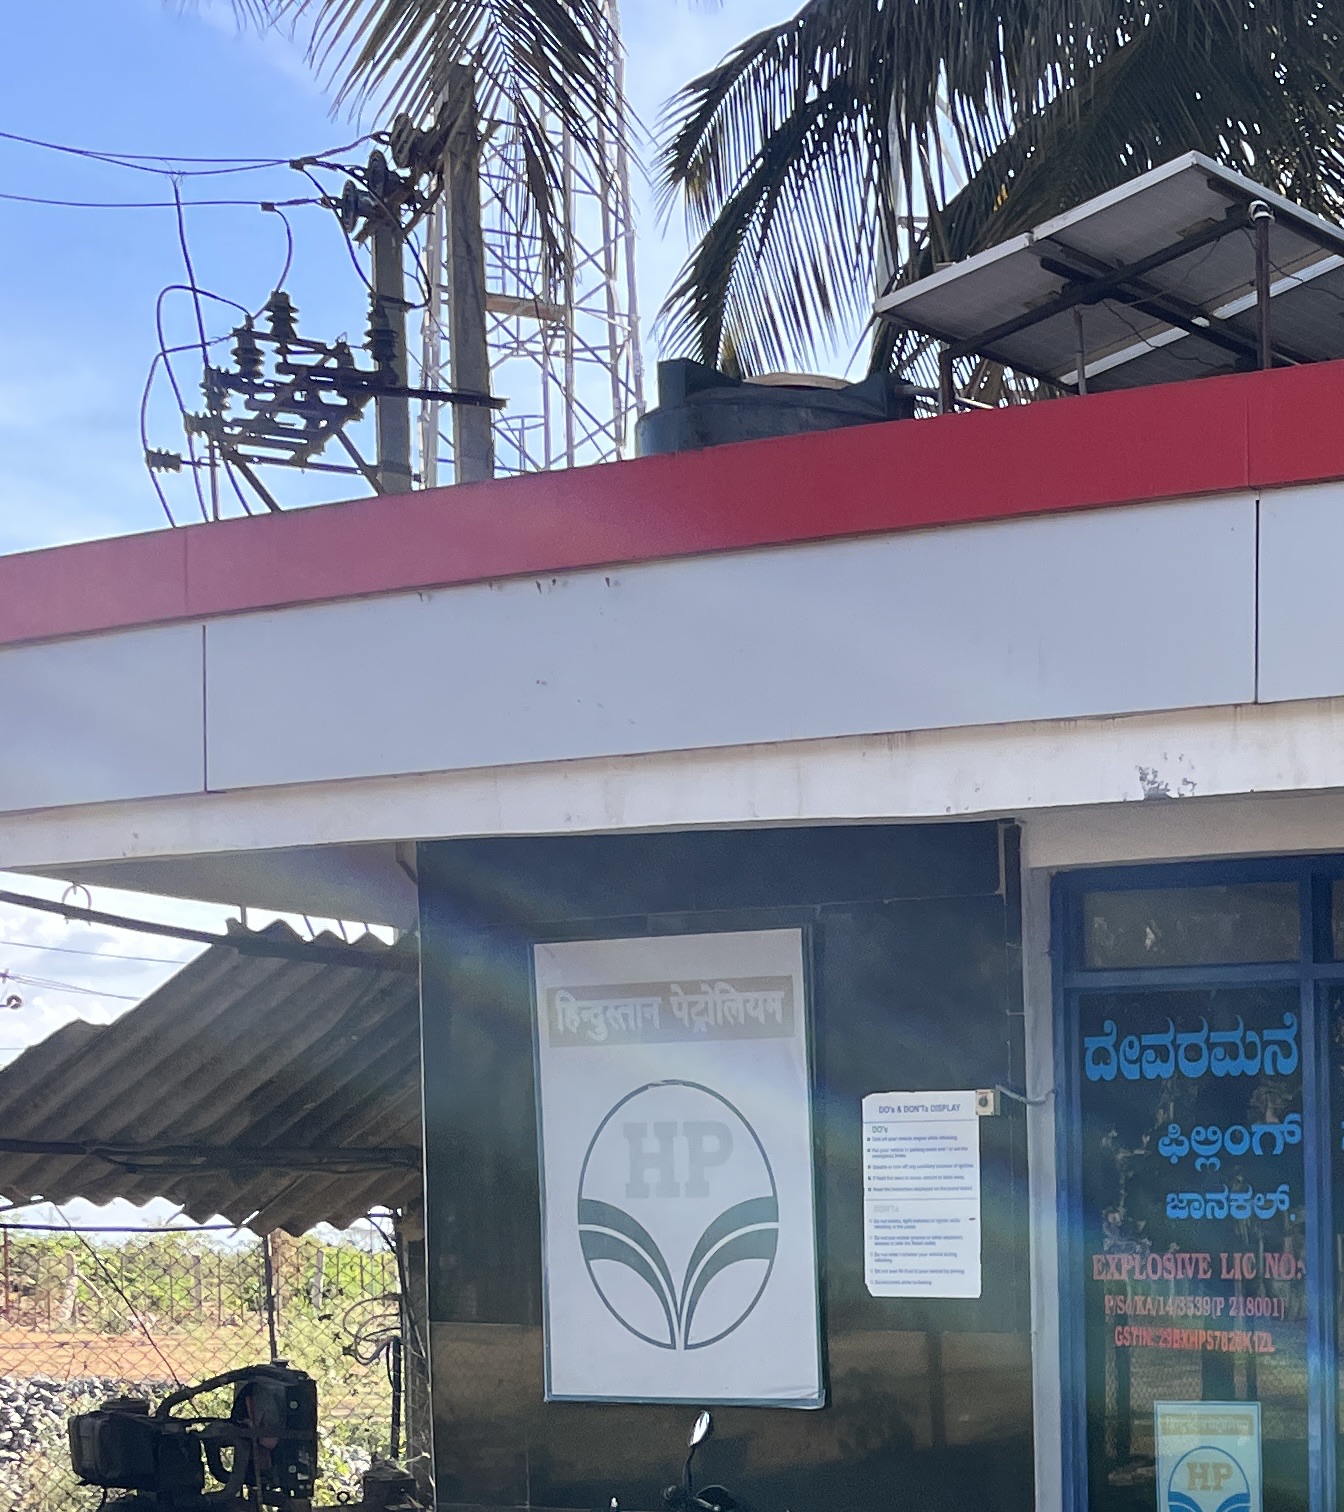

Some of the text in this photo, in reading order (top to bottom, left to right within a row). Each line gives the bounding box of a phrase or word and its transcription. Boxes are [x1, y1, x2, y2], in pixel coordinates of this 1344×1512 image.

[1083, 1011, 1299, 1082] ದೇವರಮನೆ
[622, 1121, 734, 1200] HP
[1157, 1112, 1302, 1172] ಫಿಲ್ಲಿಂಗ್
[1092, 1253, 1212, 1280] EXPLOSIVE
[1220, 1252, 1257, 1279] LIC
[1187, 1462, 1233, 1491] HP
